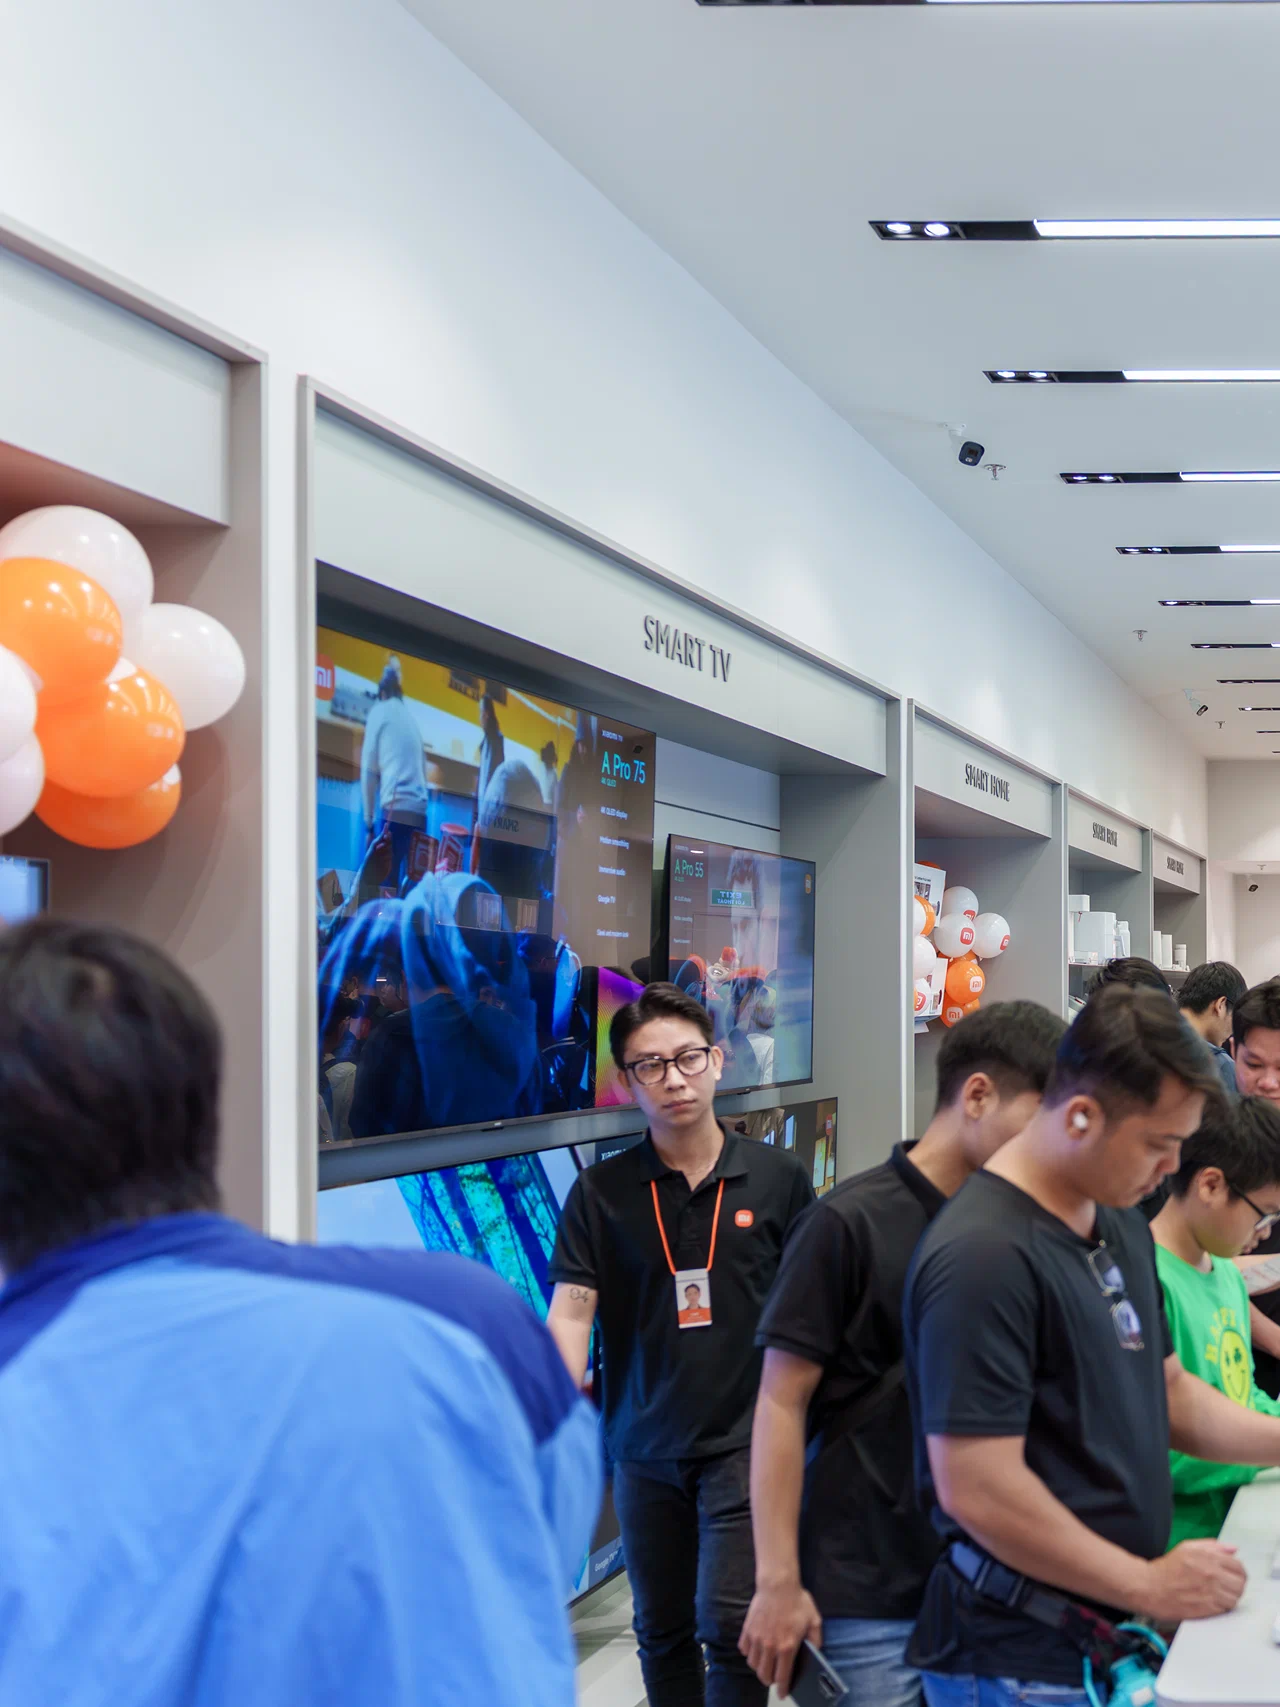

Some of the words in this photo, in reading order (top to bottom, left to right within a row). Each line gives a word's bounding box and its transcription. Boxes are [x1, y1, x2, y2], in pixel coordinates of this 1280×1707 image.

[644, 615, 706, 671] SMART
[709, 644, 731, 682] TV
[601, 751, 611, 775] A
[613, 753, 631, 780] Pro
[633, 760, 646, 784] 75
[965, 763, 989, 792] SMART
[990, 774, 1010, 802] HOME
[674, 859, 680, 874] A
[682, 861, 693, 876] Pro
[695, 862, 704, 878] 55
